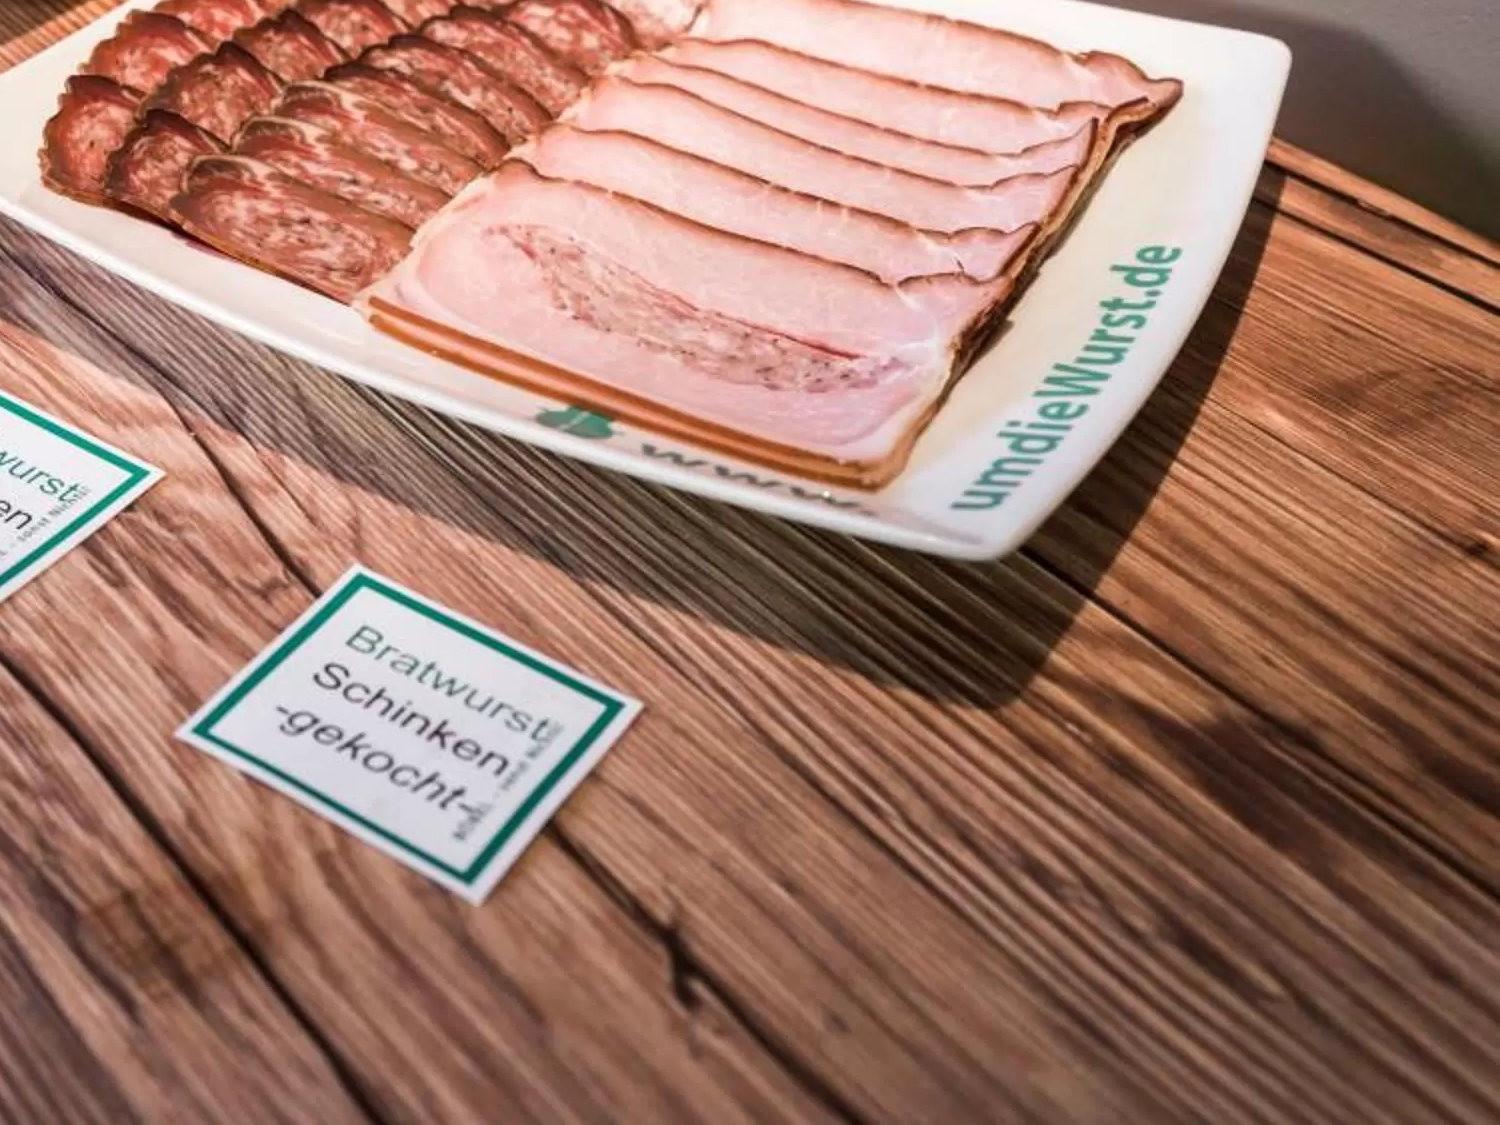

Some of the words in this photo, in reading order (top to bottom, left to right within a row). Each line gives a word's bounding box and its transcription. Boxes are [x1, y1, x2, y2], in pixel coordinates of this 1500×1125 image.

[950, 245, 1182, 511] umdieWurst.de
[312, 661, 510, 776] Schinken
[345, 623, 554, 743] Bratwurst
[275, 703, 485, 814] -gekocht-
